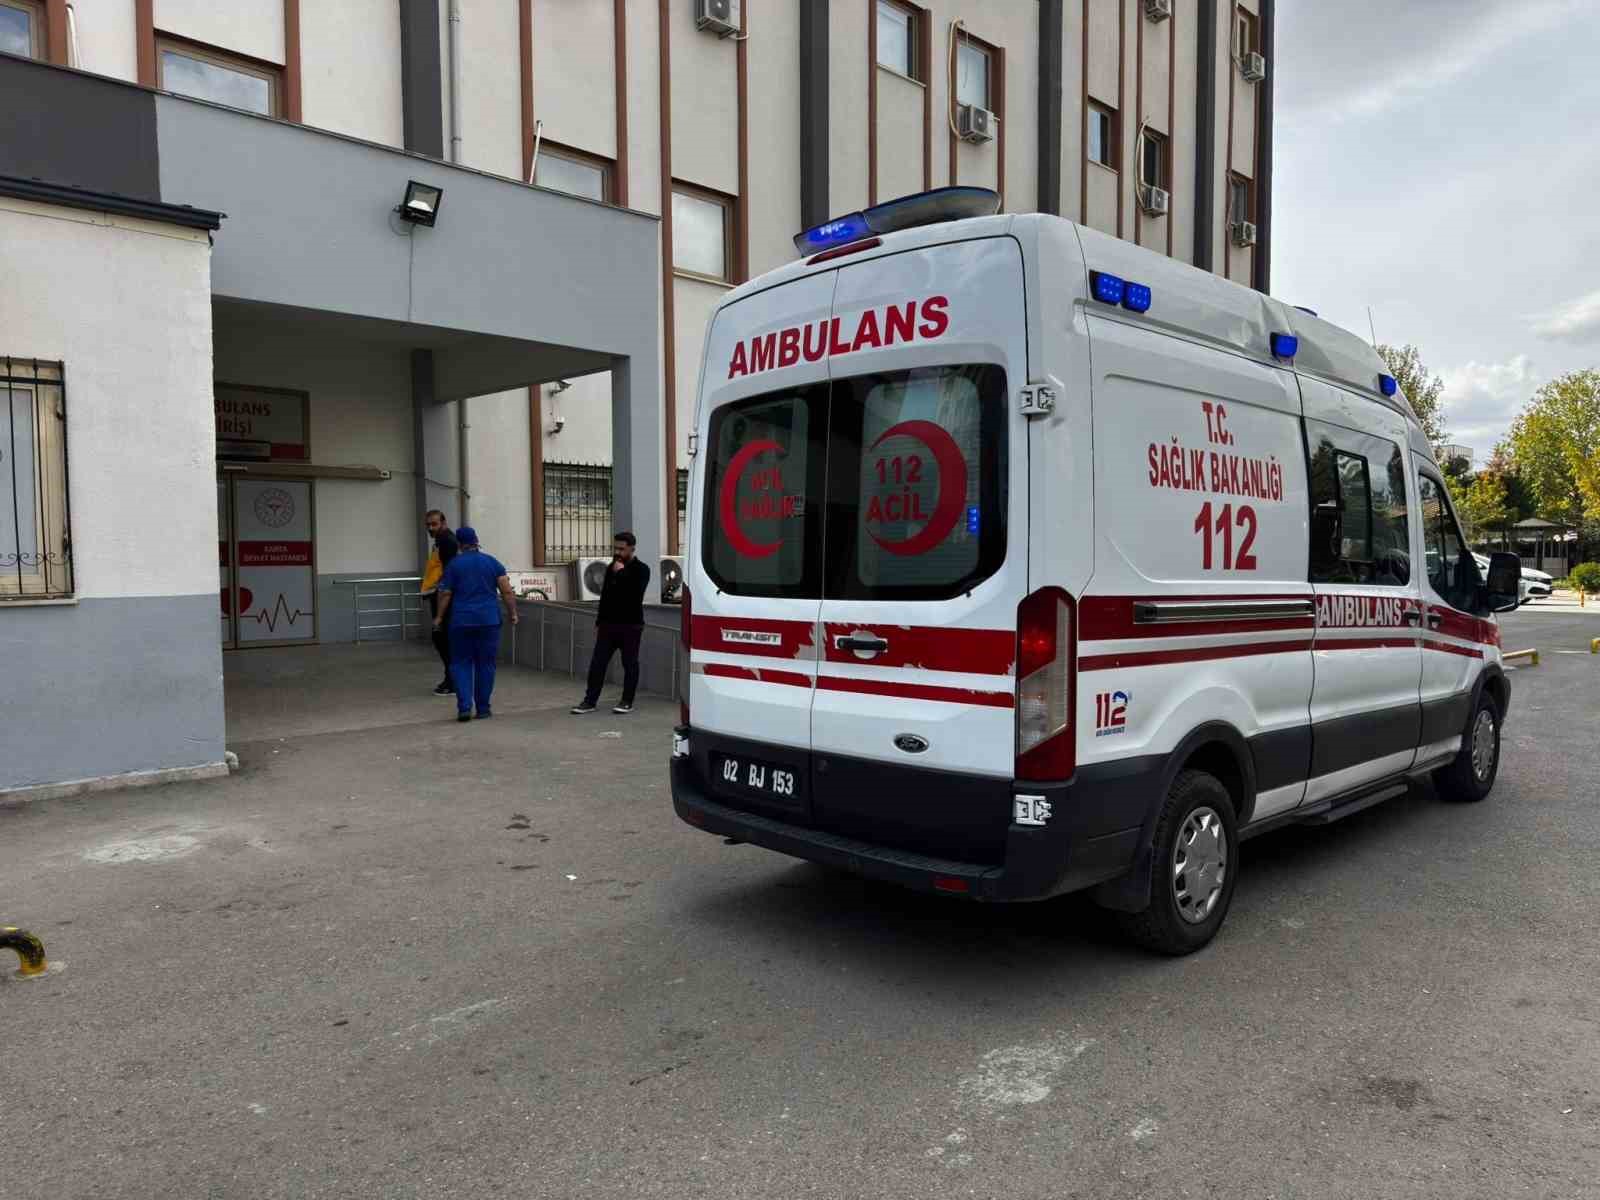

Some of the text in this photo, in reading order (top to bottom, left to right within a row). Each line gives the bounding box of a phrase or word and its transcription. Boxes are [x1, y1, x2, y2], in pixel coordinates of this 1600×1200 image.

[728, 296, 949, 379] AMBULANS
[215, 400, 272, 416] BULANS
[217, 415, 252, 436] İRİŞİ
[1202, 401, 1234, 445] T.C.
[875, 454, 923, 485] 112
[1148, 436, 1283, 501] SAĞLIK BAKANLIĞI
[865, 487, 929, 524] ACİL
[1194, 502, 1257, 570] 112
[1320, 596, 1401, 627] AMBULANS
[723, 631, 780, 643] TRANSIT
[1096, 691, 1128, 728] 112
[723, 759, 794, 795] 02 BJ 153
